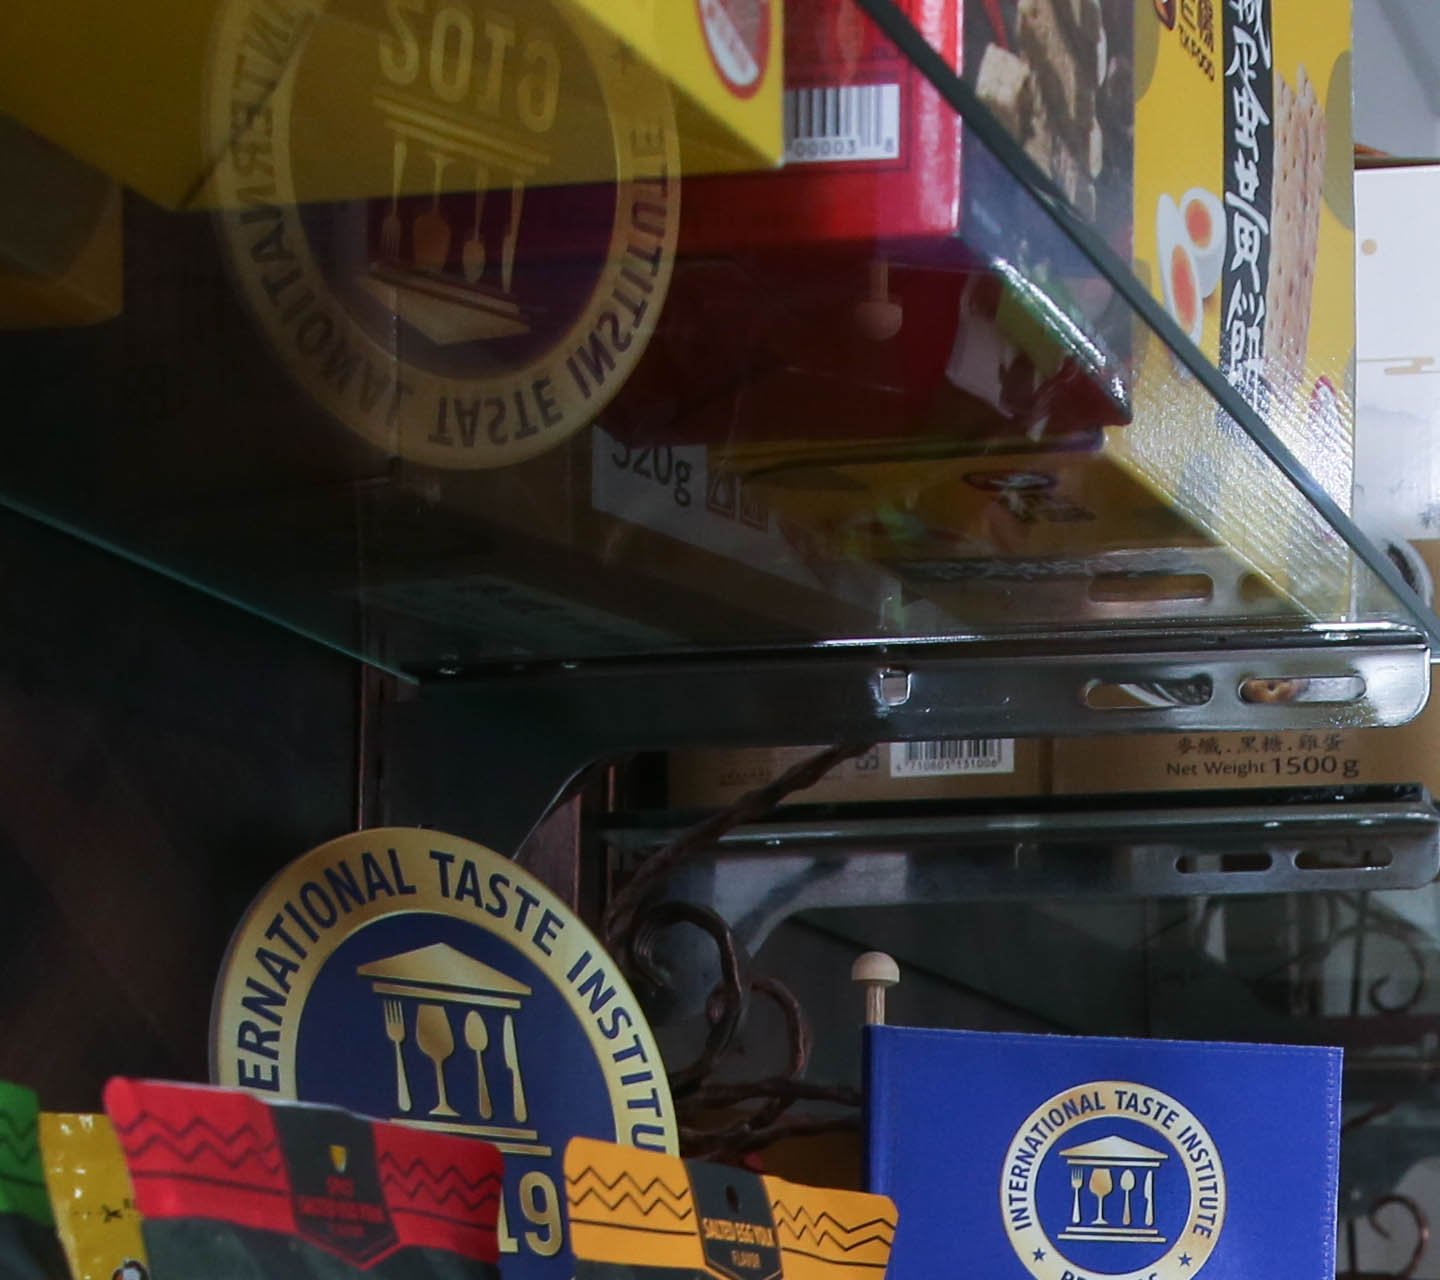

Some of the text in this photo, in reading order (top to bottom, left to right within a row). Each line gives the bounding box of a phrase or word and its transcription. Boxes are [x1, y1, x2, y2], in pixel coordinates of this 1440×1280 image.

[1166, 756, 1360, 781] Net Weight 1500 g
[238, 848, 667, 1154] ERNATIONAL TASTE INSTITU
[1009, 1089, 1219, 1240] INTERNATIONAL TASTE INSTITUTE
